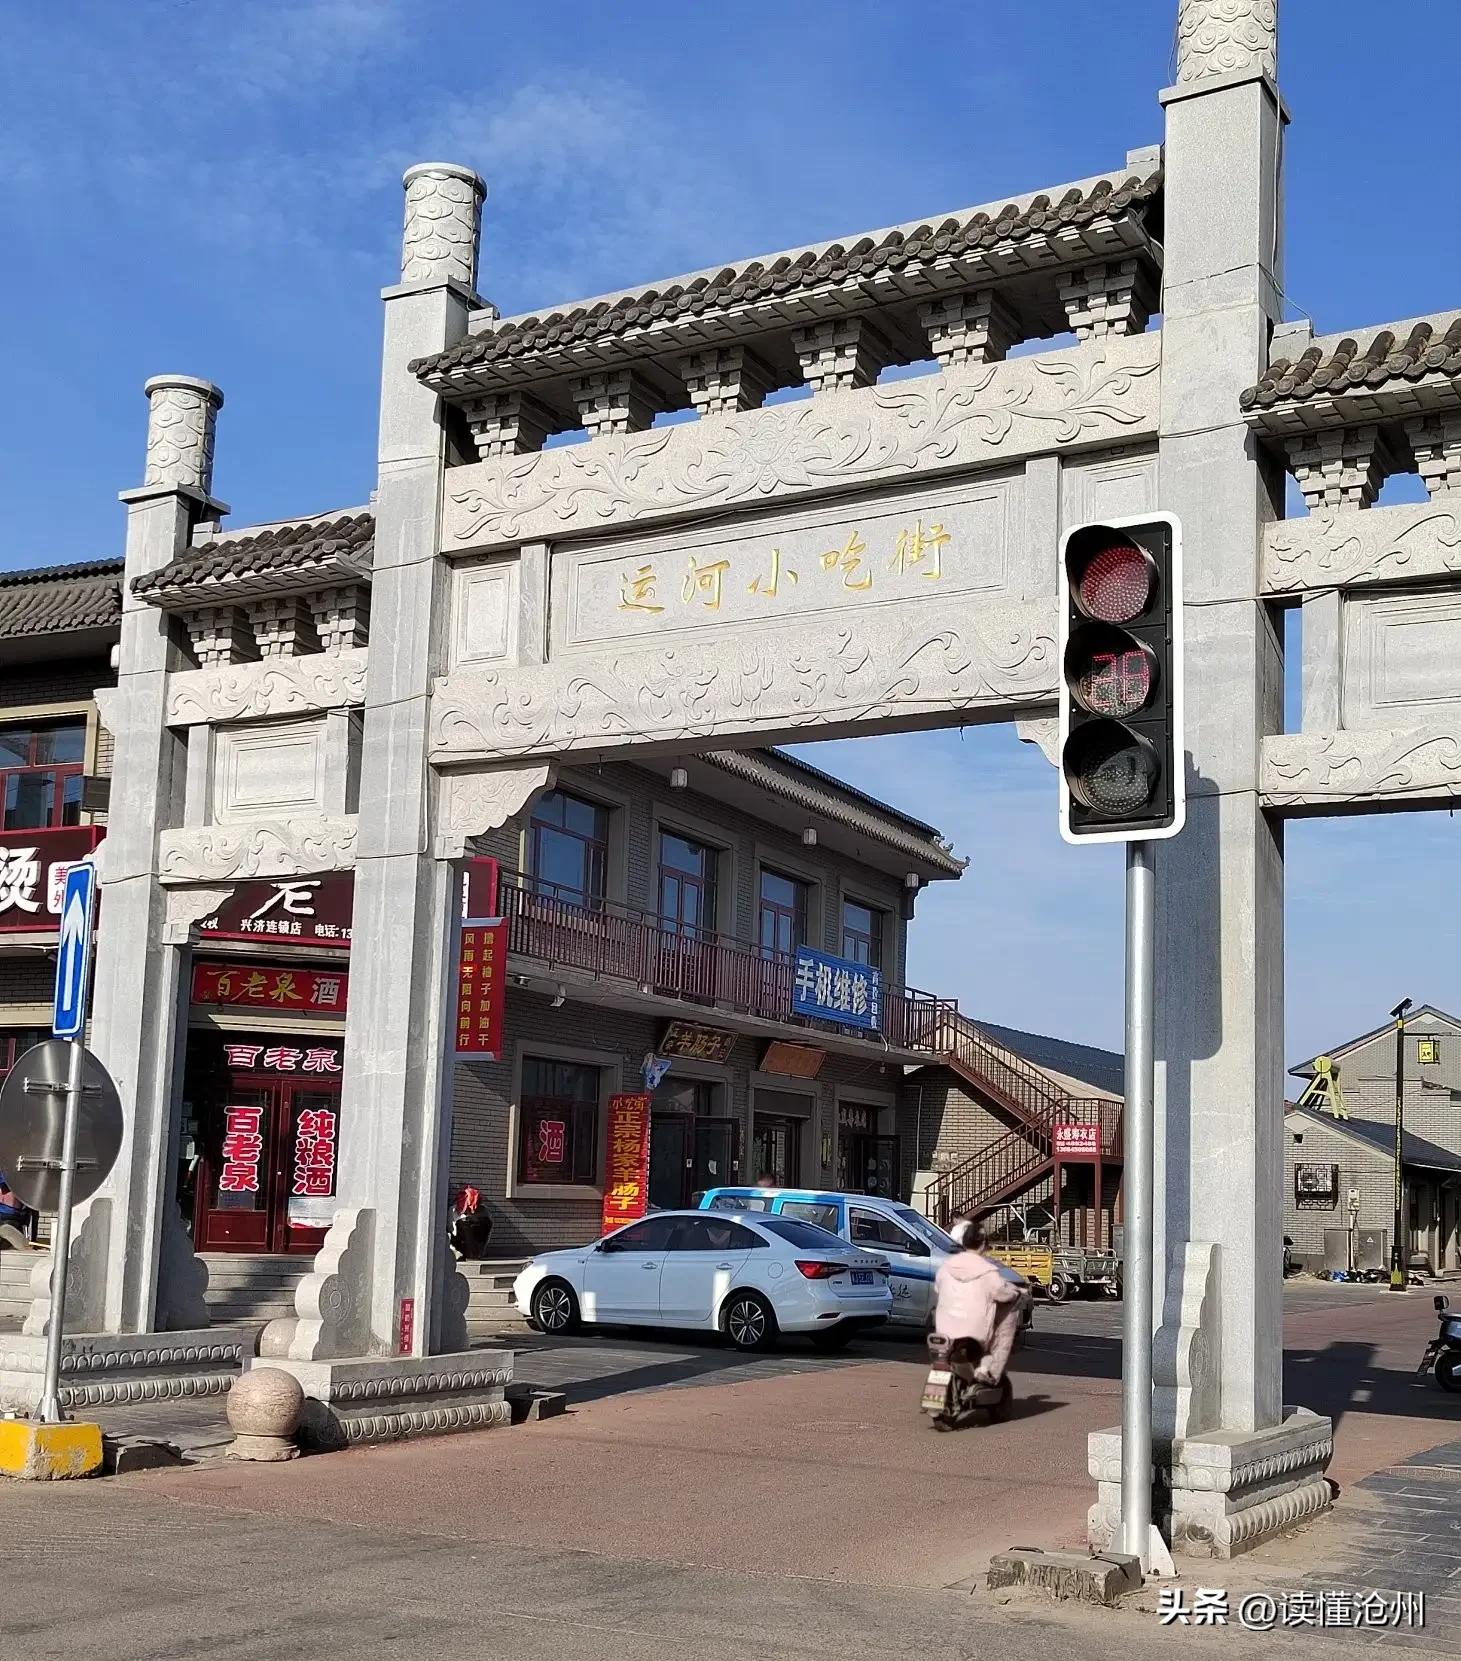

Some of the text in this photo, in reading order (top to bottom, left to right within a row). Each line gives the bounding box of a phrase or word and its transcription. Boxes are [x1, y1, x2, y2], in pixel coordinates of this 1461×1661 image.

[617, 519, 951, 614] 运河小吃街
[240, 919, 303, 936] 兴济连锁店
[206, 970, 340, 1006] 百老泉 酒
[796, 958, 868, 1015] 手机维修
[224, 1045, 343, 1072] 百老泉
[219, 1105, 263, 1192] 百老泉
[292, 1109, 336, 1196] 纯粮酒
[539, 1120, 565, 1163] 酒
[609, 1111, 642, 1210] 正宗杨家羊肠子
